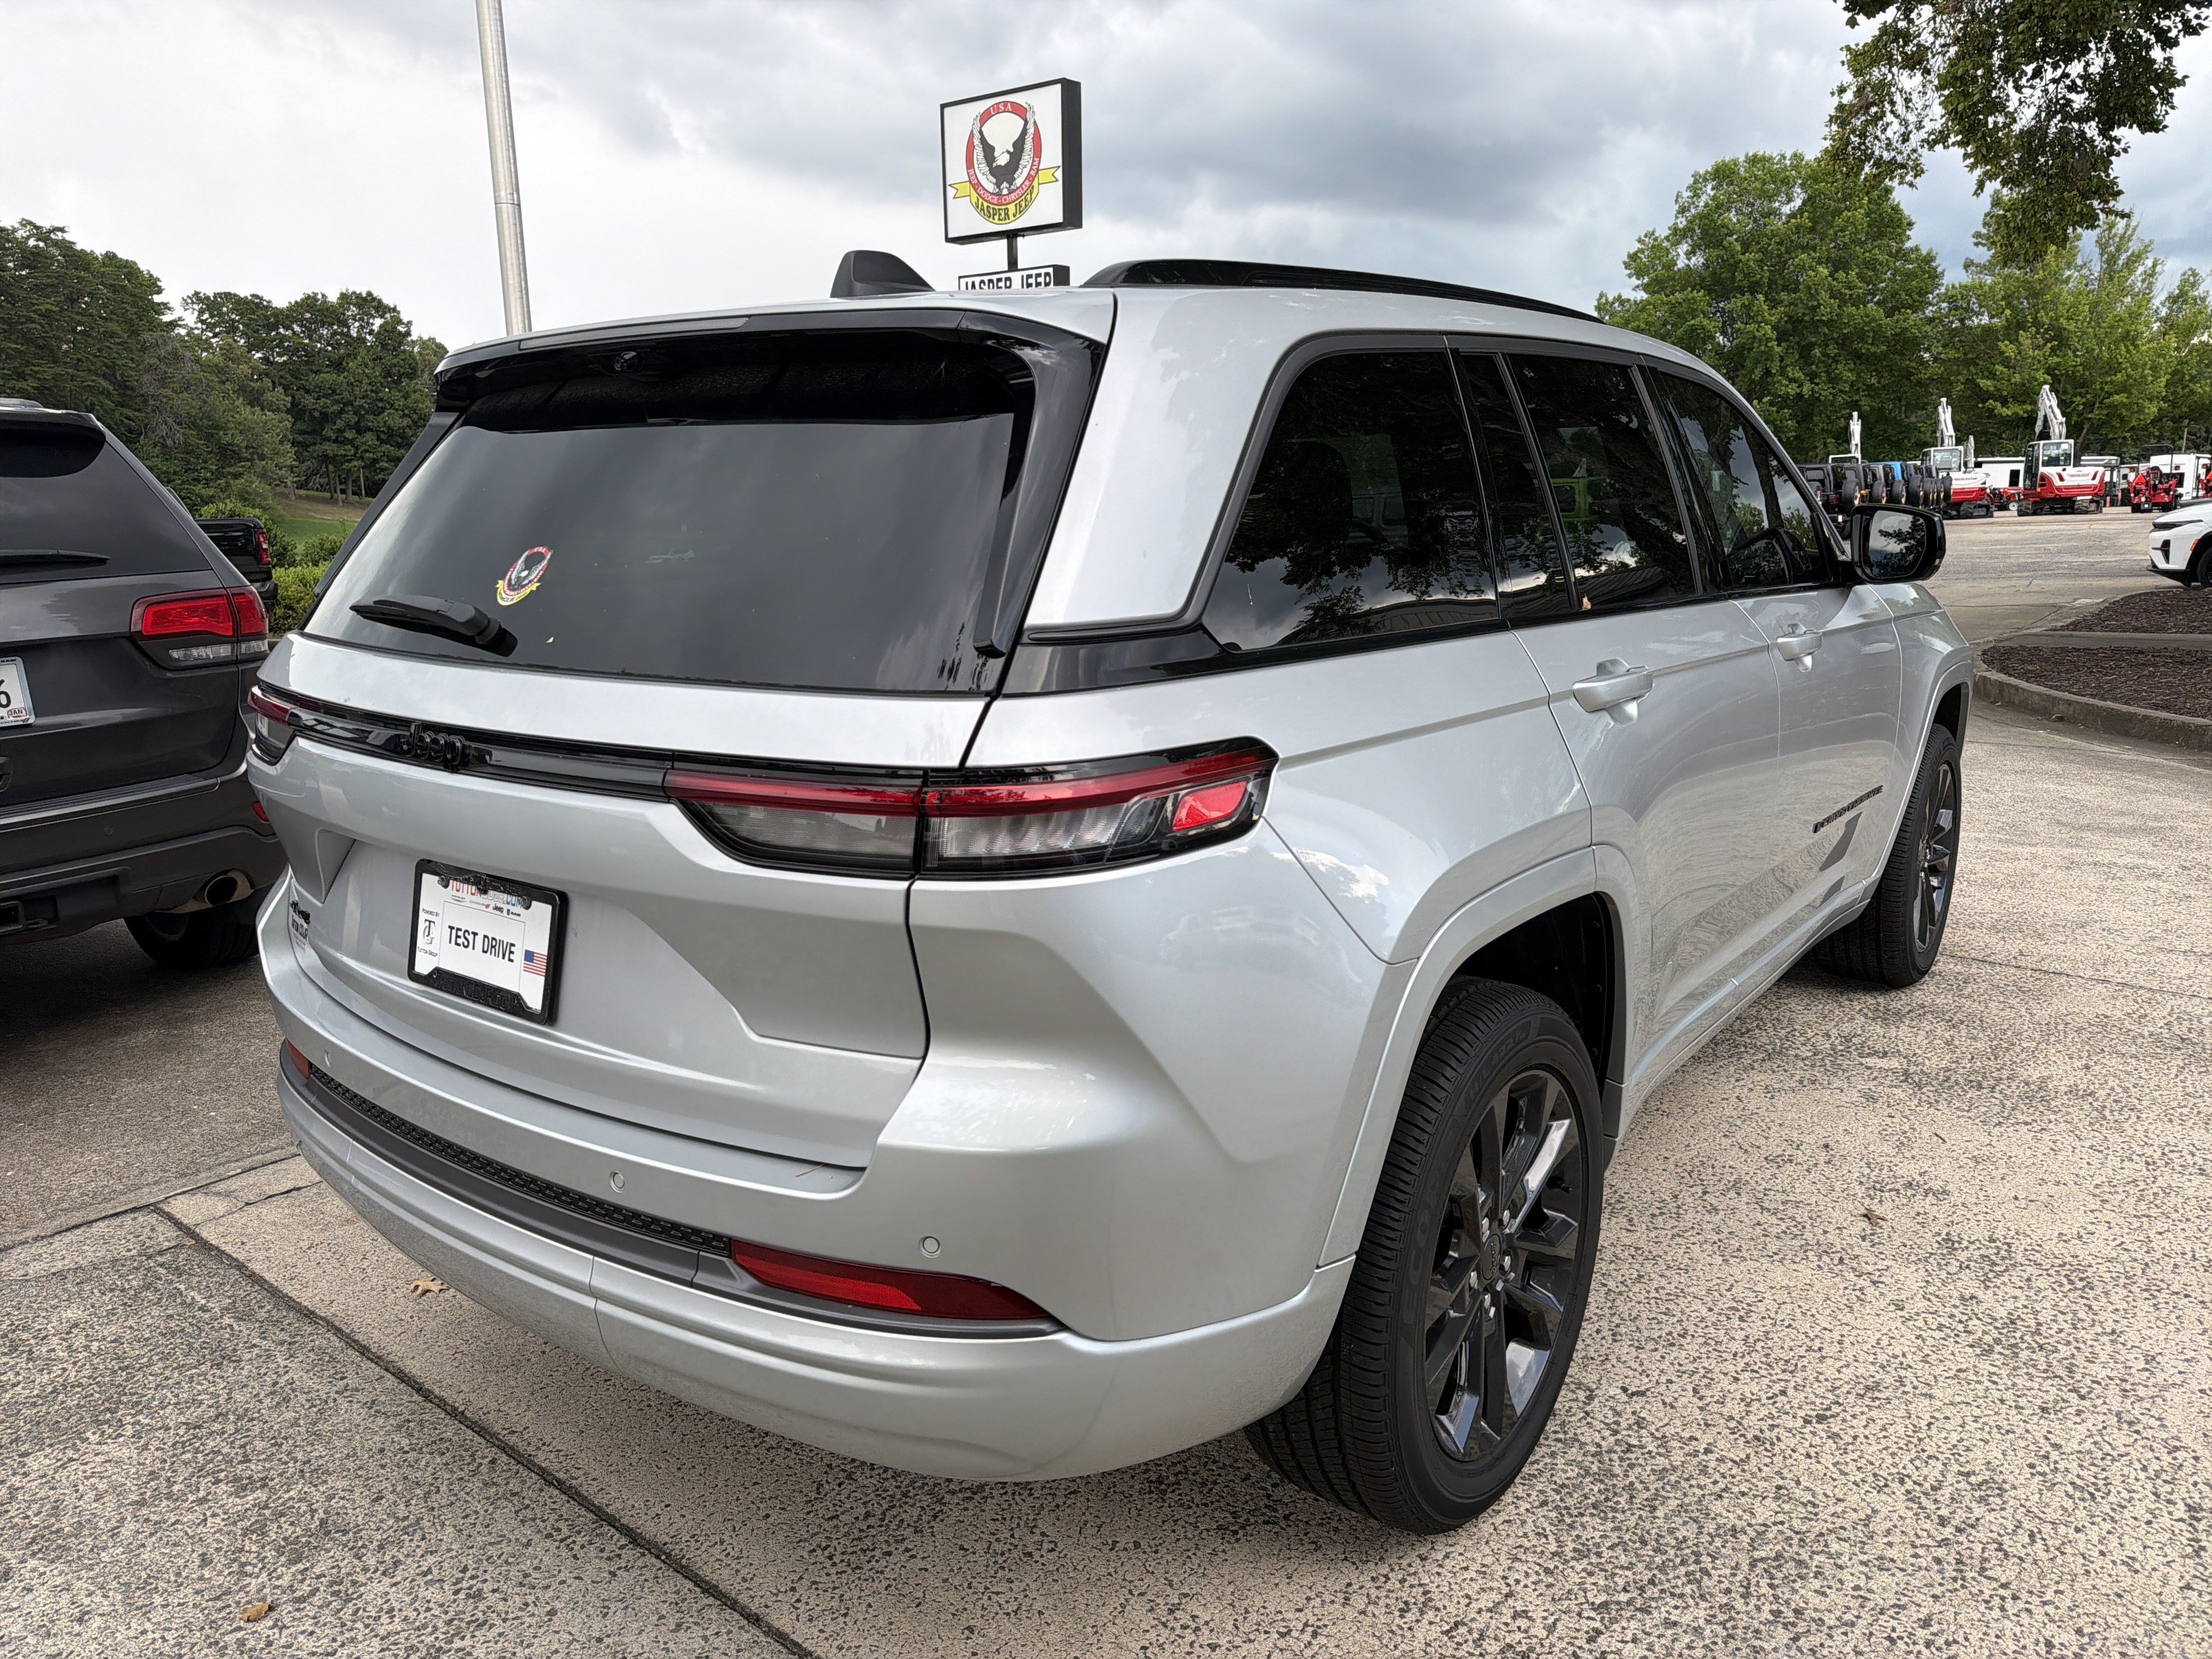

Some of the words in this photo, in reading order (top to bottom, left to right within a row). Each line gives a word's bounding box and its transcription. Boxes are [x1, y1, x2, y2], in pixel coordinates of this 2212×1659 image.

[990, 103, 1012, 115] USA
[968, 169, 978, 185] JEEP
[978, 187, 998, 204] DODGE
[1002, 180, 1031, 203] CHRYSLER
[1030, 157, 1040, 177] RAM
[975, 196, 1011, 222] JASPER
[1013, 185, 1035, 218] JEEP
[400, 721, 465, 771] Jeep
[492, 903, 504, 915] Jeep
[448, 925, 478, 950] TEST
[482, 934, 516, 963] DRIVE
